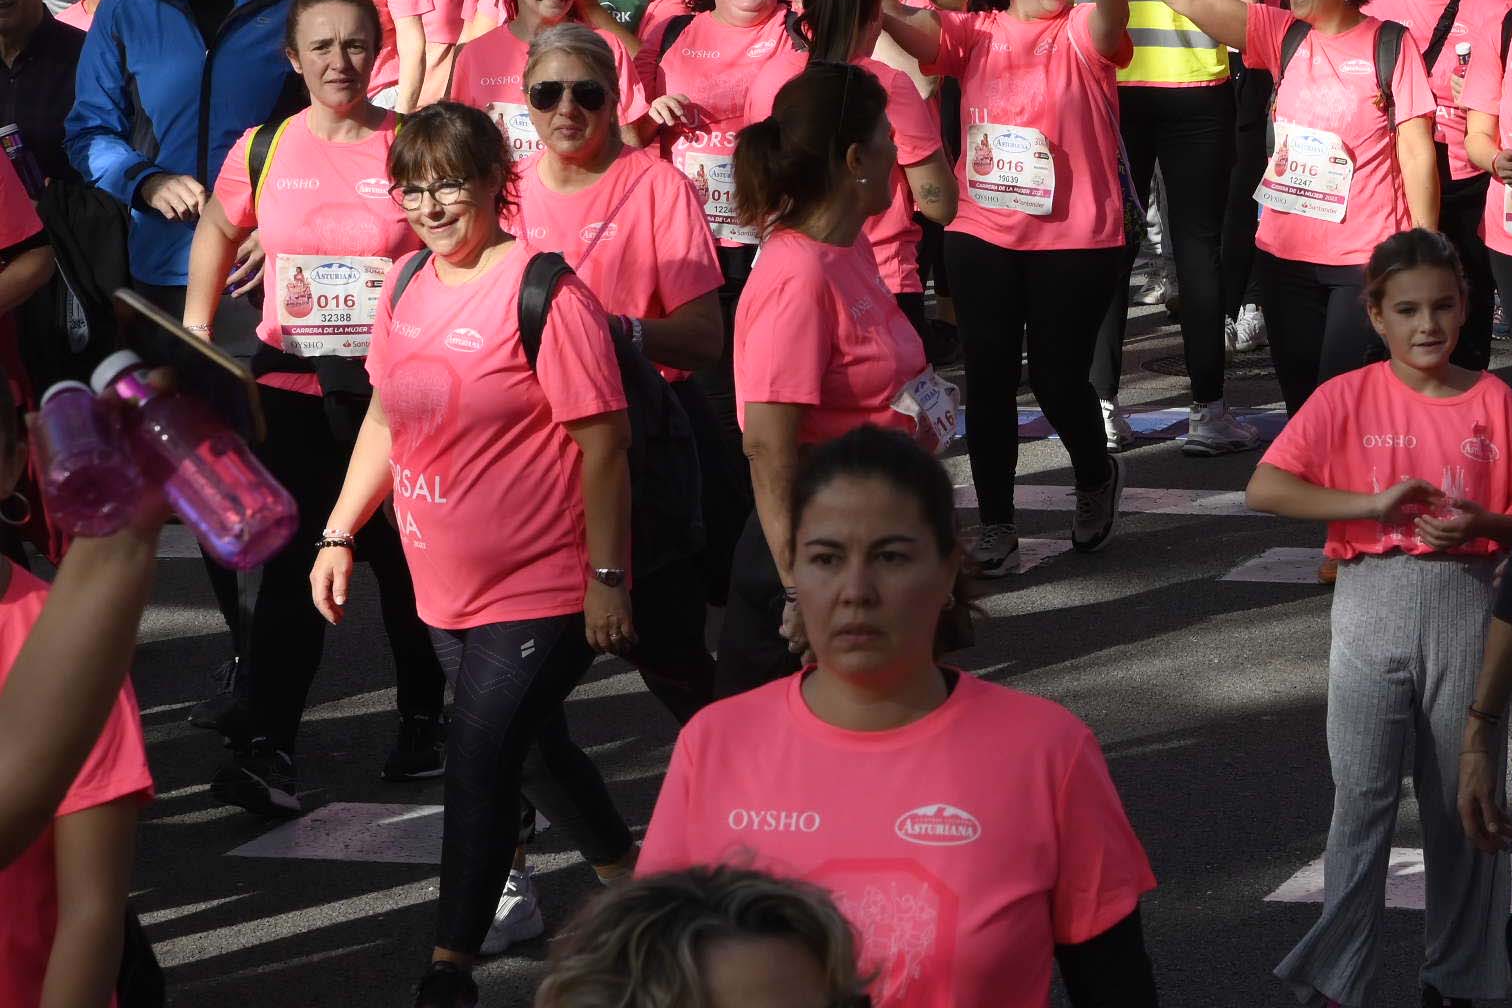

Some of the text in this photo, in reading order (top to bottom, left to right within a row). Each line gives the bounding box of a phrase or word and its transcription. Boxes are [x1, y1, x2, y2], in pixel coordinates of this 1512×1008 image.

[681, 48, 721, 59] OYSHO
[480, 75, 520, 87] OYSHO
[996, 159, 1024, 173] 016
[276, 178, 320, 190] OYSHO
[1289, 176, 1313, 187] 12247
[314, 268, 359, 282] ASTURIANA
[316, 294, 356, 309] 016
[291, 325, 368, 335] CARRERA DE LA MUJER
[1362, 433, 1417, 449] OYSHO
[728, 808, 820, 833] OYSHO
[903, 818, 974, 838] ASTURIANA
